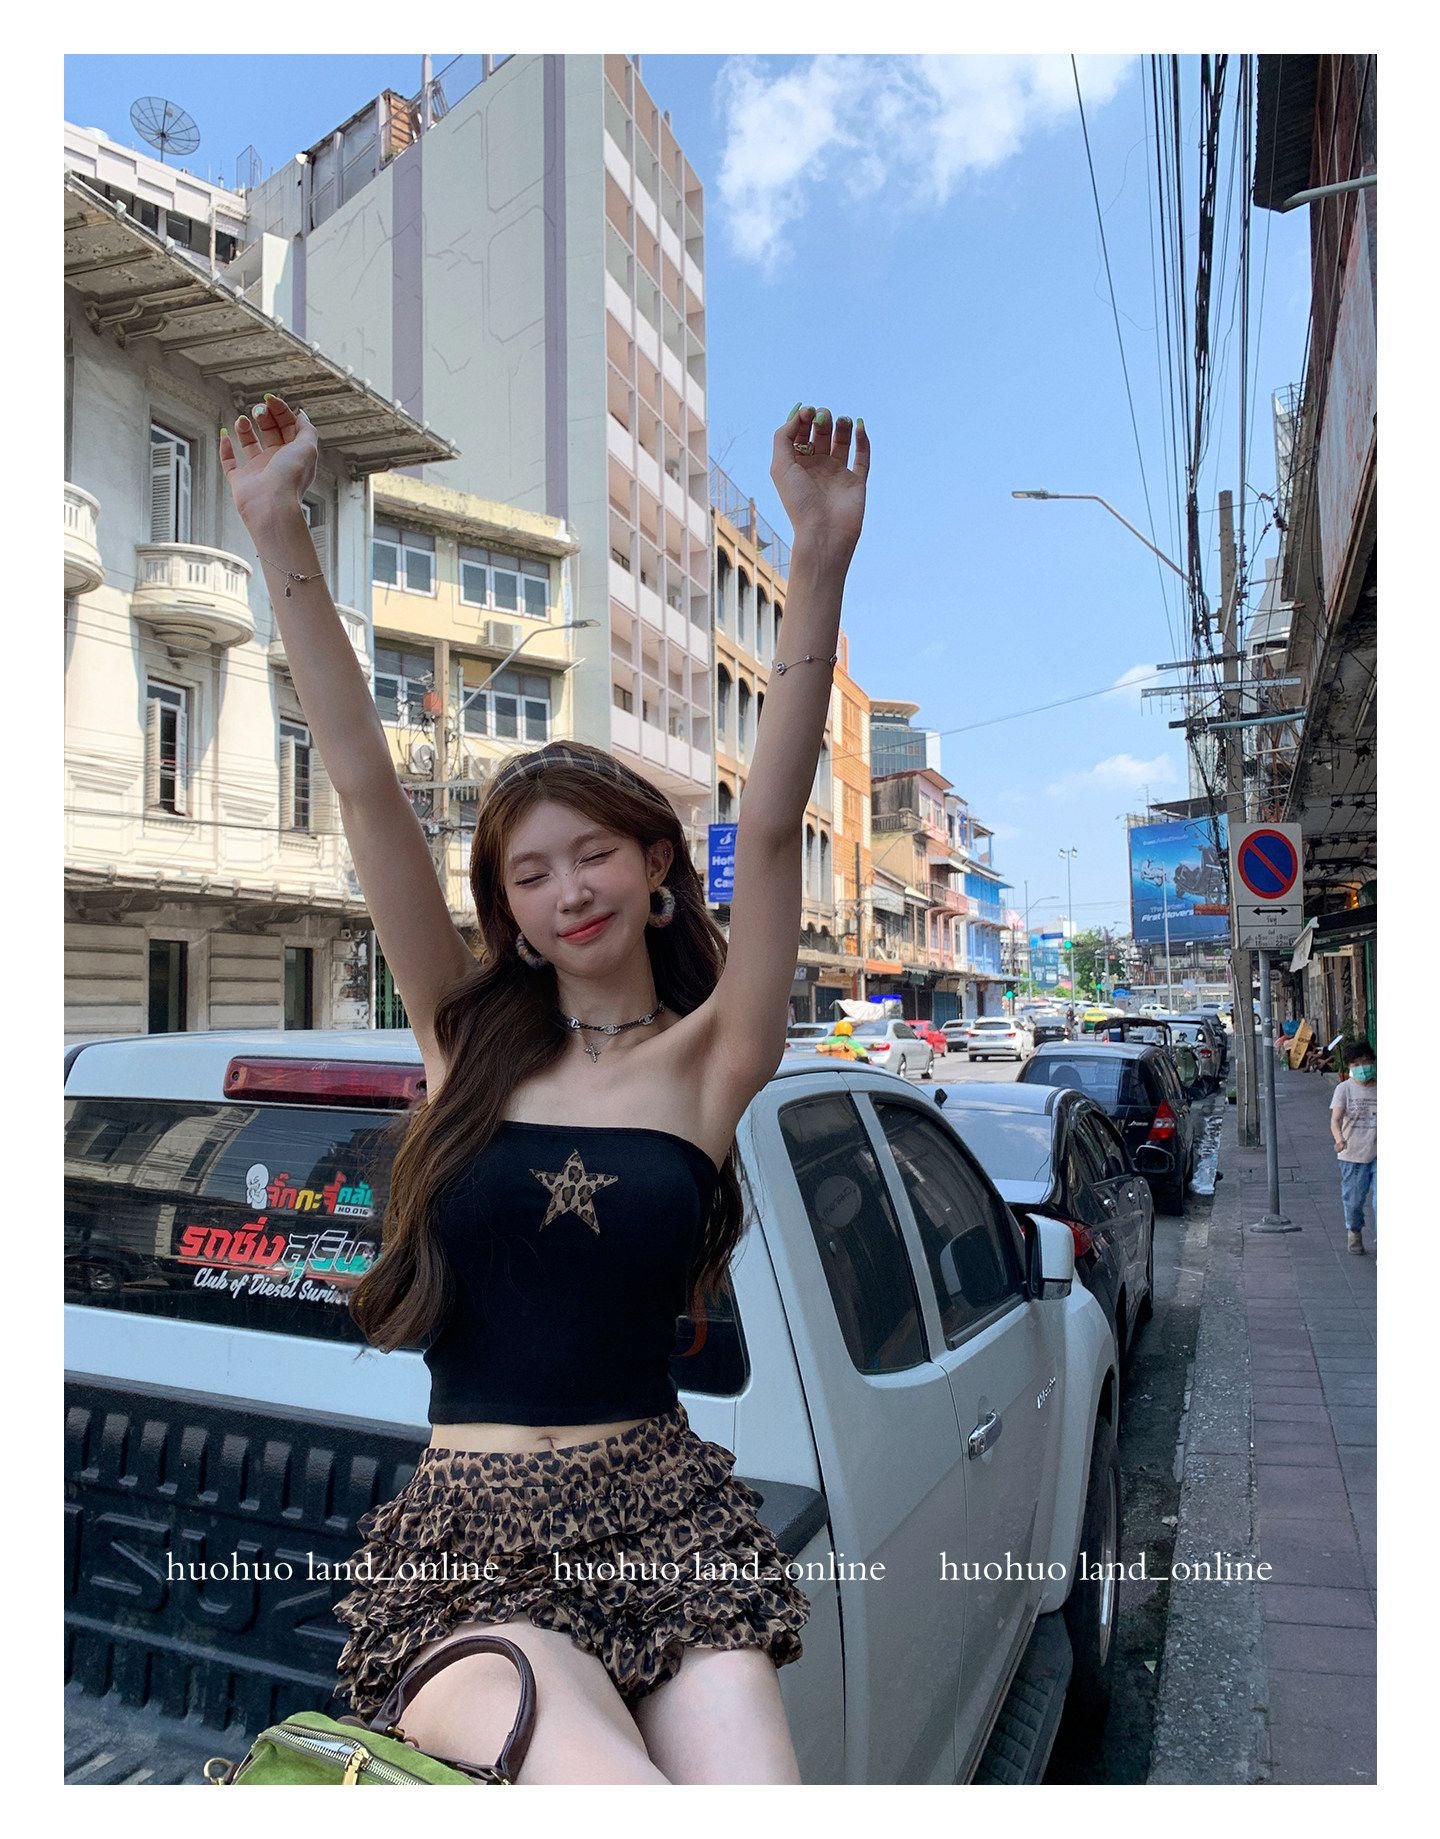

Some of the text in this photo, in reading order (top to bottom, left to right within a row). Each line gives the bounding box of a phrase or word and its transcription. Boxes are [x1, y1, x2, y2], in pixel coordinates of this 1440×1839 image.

[1141, 913, 1161, 922] First
[193, 1267, 228, 1290] Club
[230, 1274, 249, 1299] of
[248, 1273, 298, 1299] Diesel
